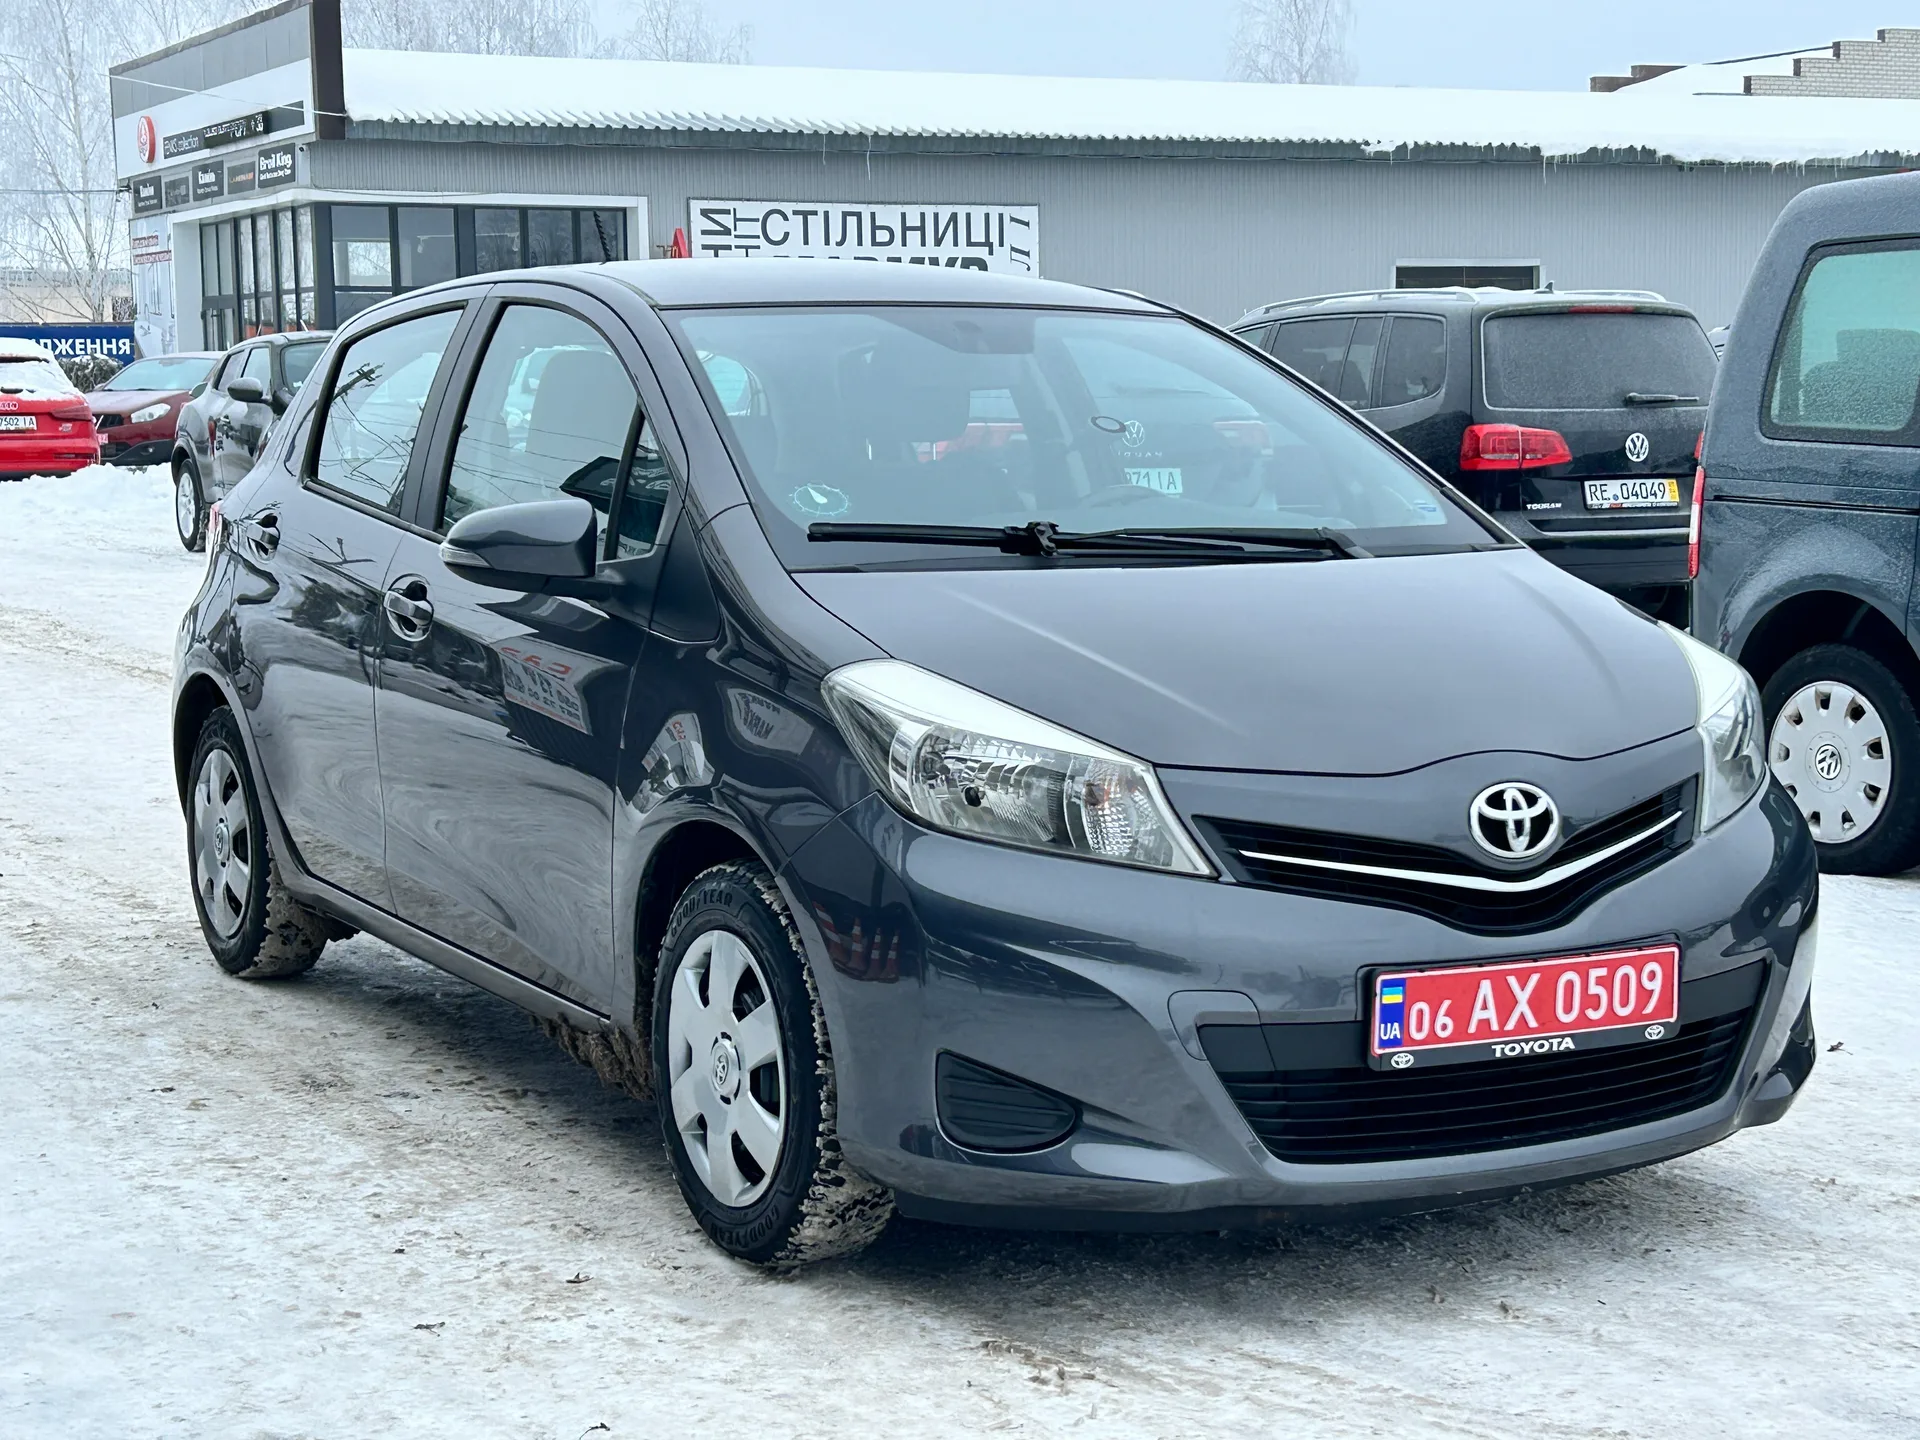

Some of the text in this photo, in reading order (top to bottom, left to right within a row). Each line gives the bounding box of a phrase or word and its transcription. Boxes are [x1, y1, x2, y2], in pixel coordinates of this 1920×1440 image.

[760, 207, 1004, 256] СТІЛЬНИЦІ
[31, 338, 131, 355] ДЖЕННЯ
[1620, 482, 1666, 500] 04049
[1380, 961, 1663, 1040] UA 06 AX 0509
[1491, 1037, 1576, 1058] TOYOTA
